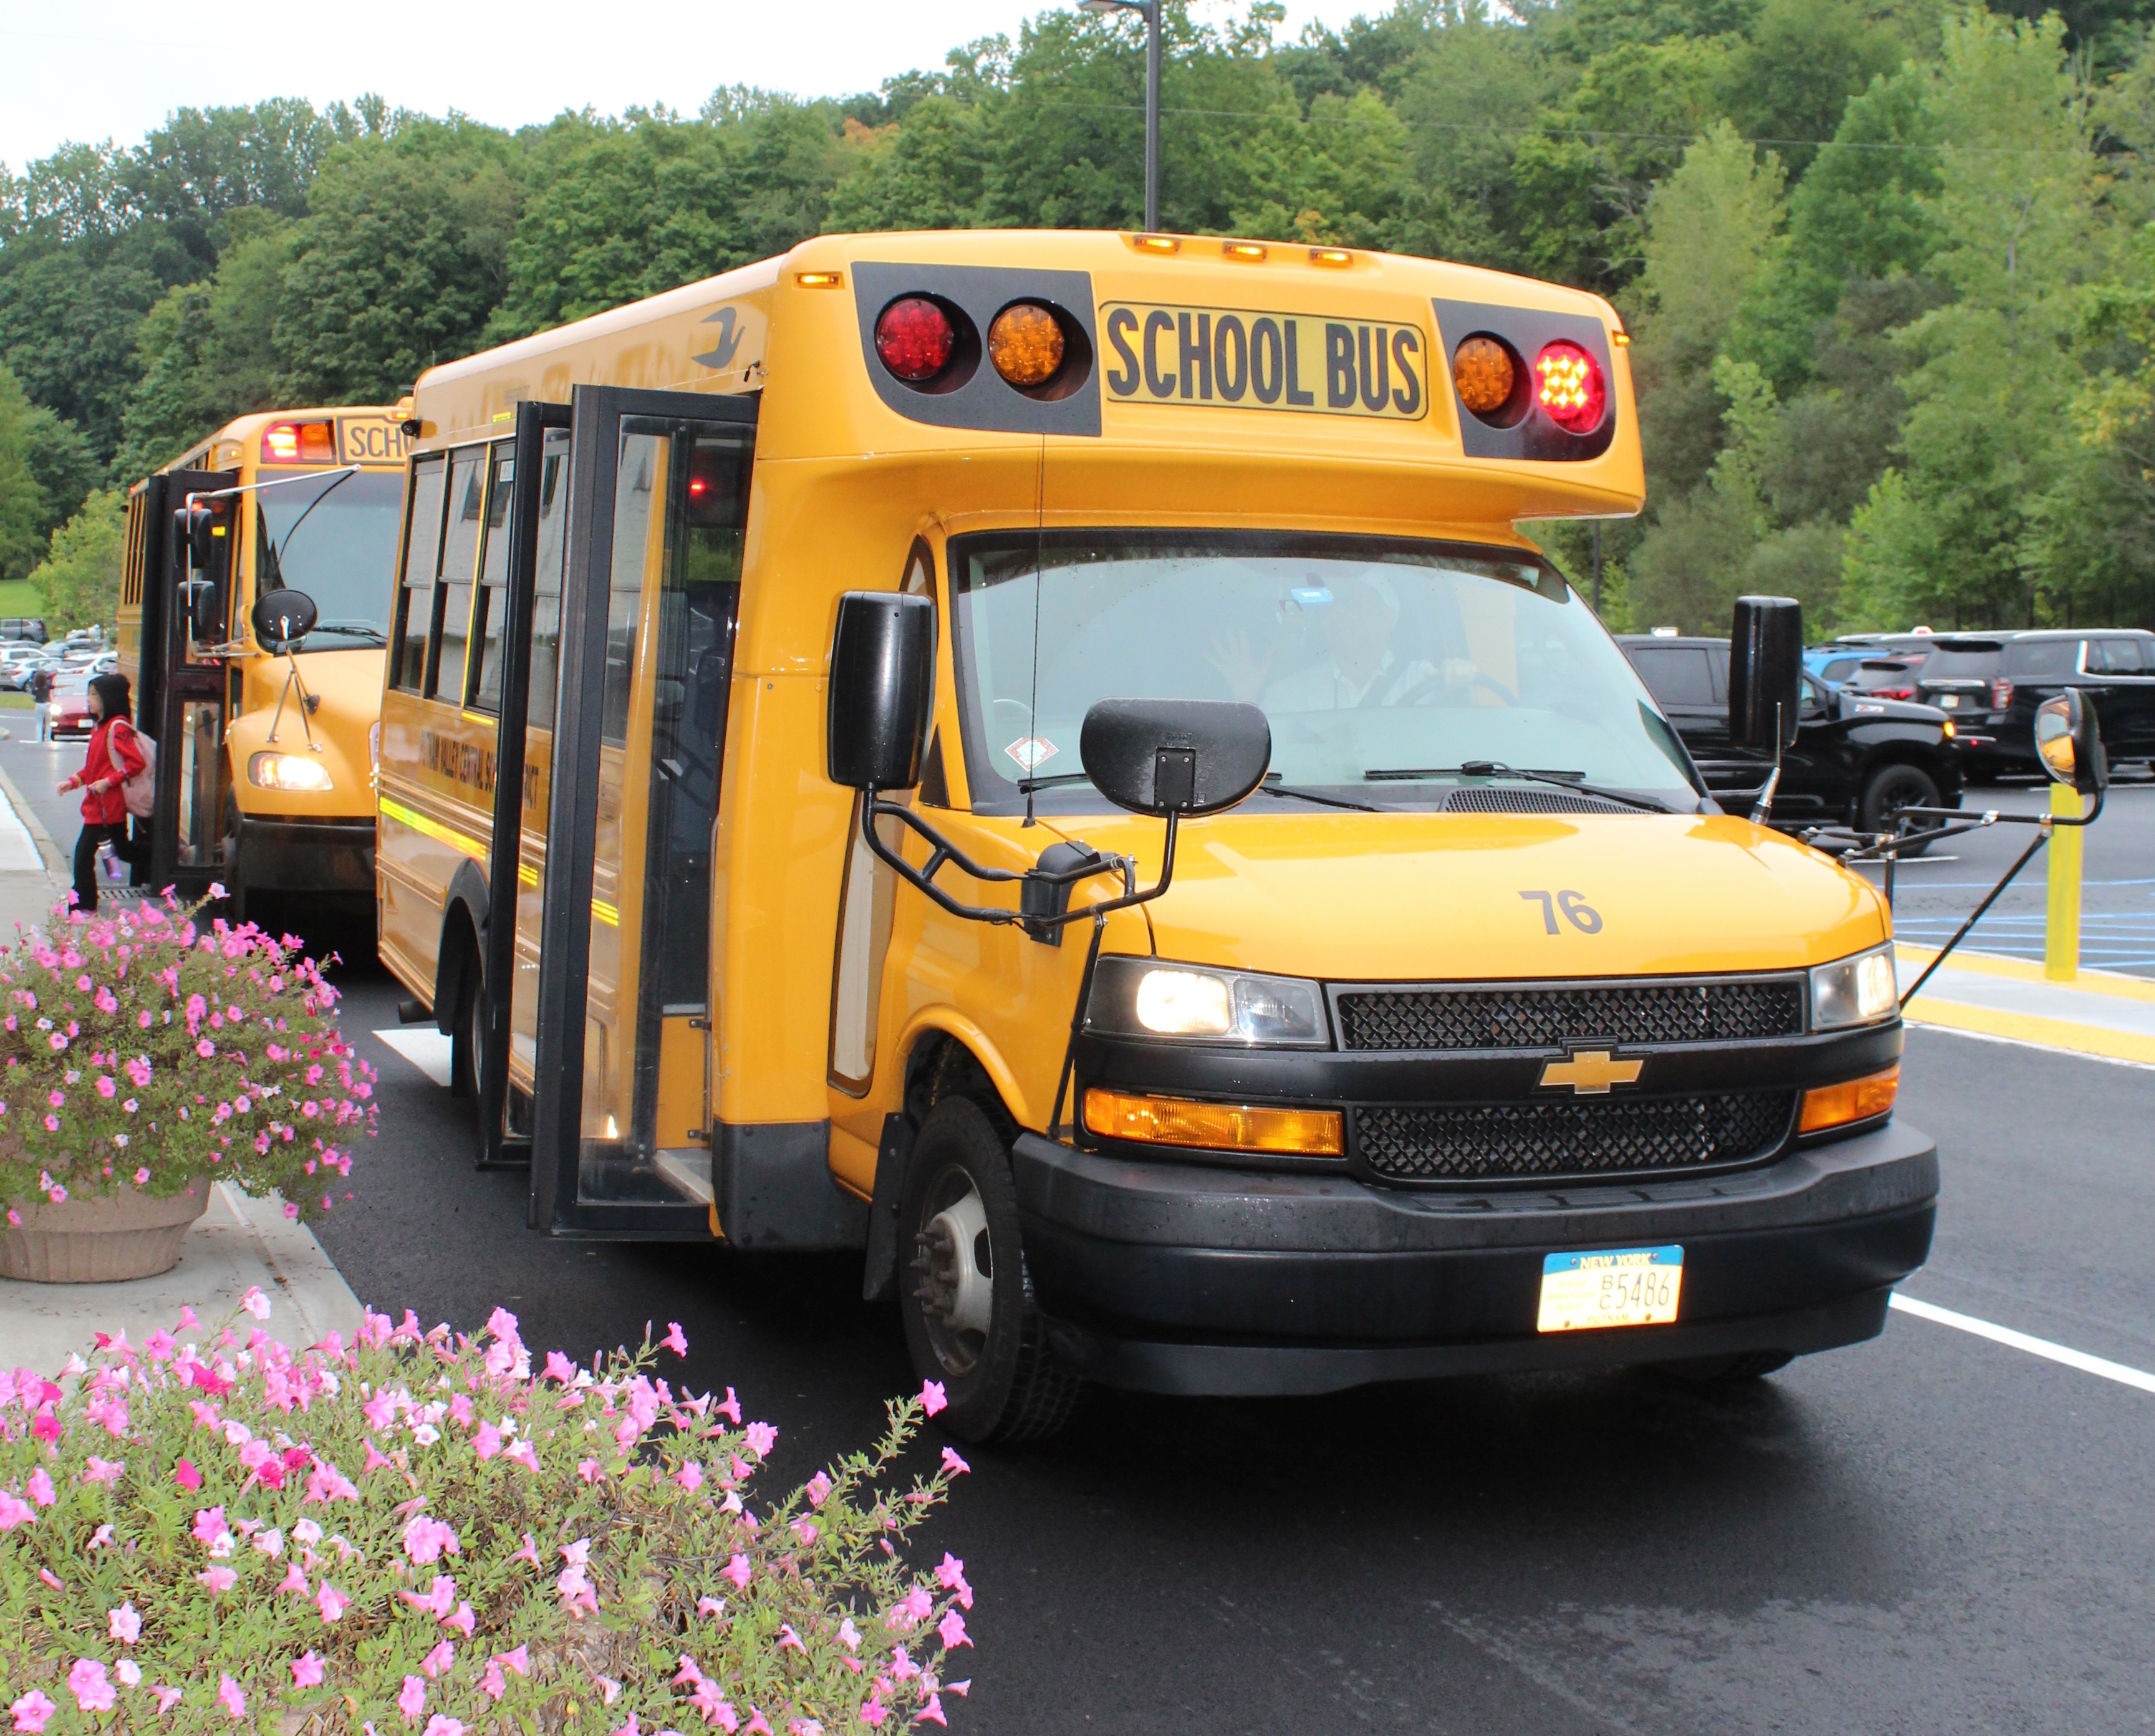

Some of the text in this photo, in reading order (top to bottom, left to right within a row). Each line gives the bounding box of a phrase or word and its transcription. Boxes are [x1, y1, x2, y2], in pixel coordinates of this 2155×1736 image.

[1107, 308, 1420, 414] SCHOOL BUS
[1517, 889, 1603, 935] 76
[1579, 1253, 1652, 1270] NEW YORK
[1616, 1272, 1670, 1309] 5486
[1588, 1314, 1629, 1324] PUTNAM
